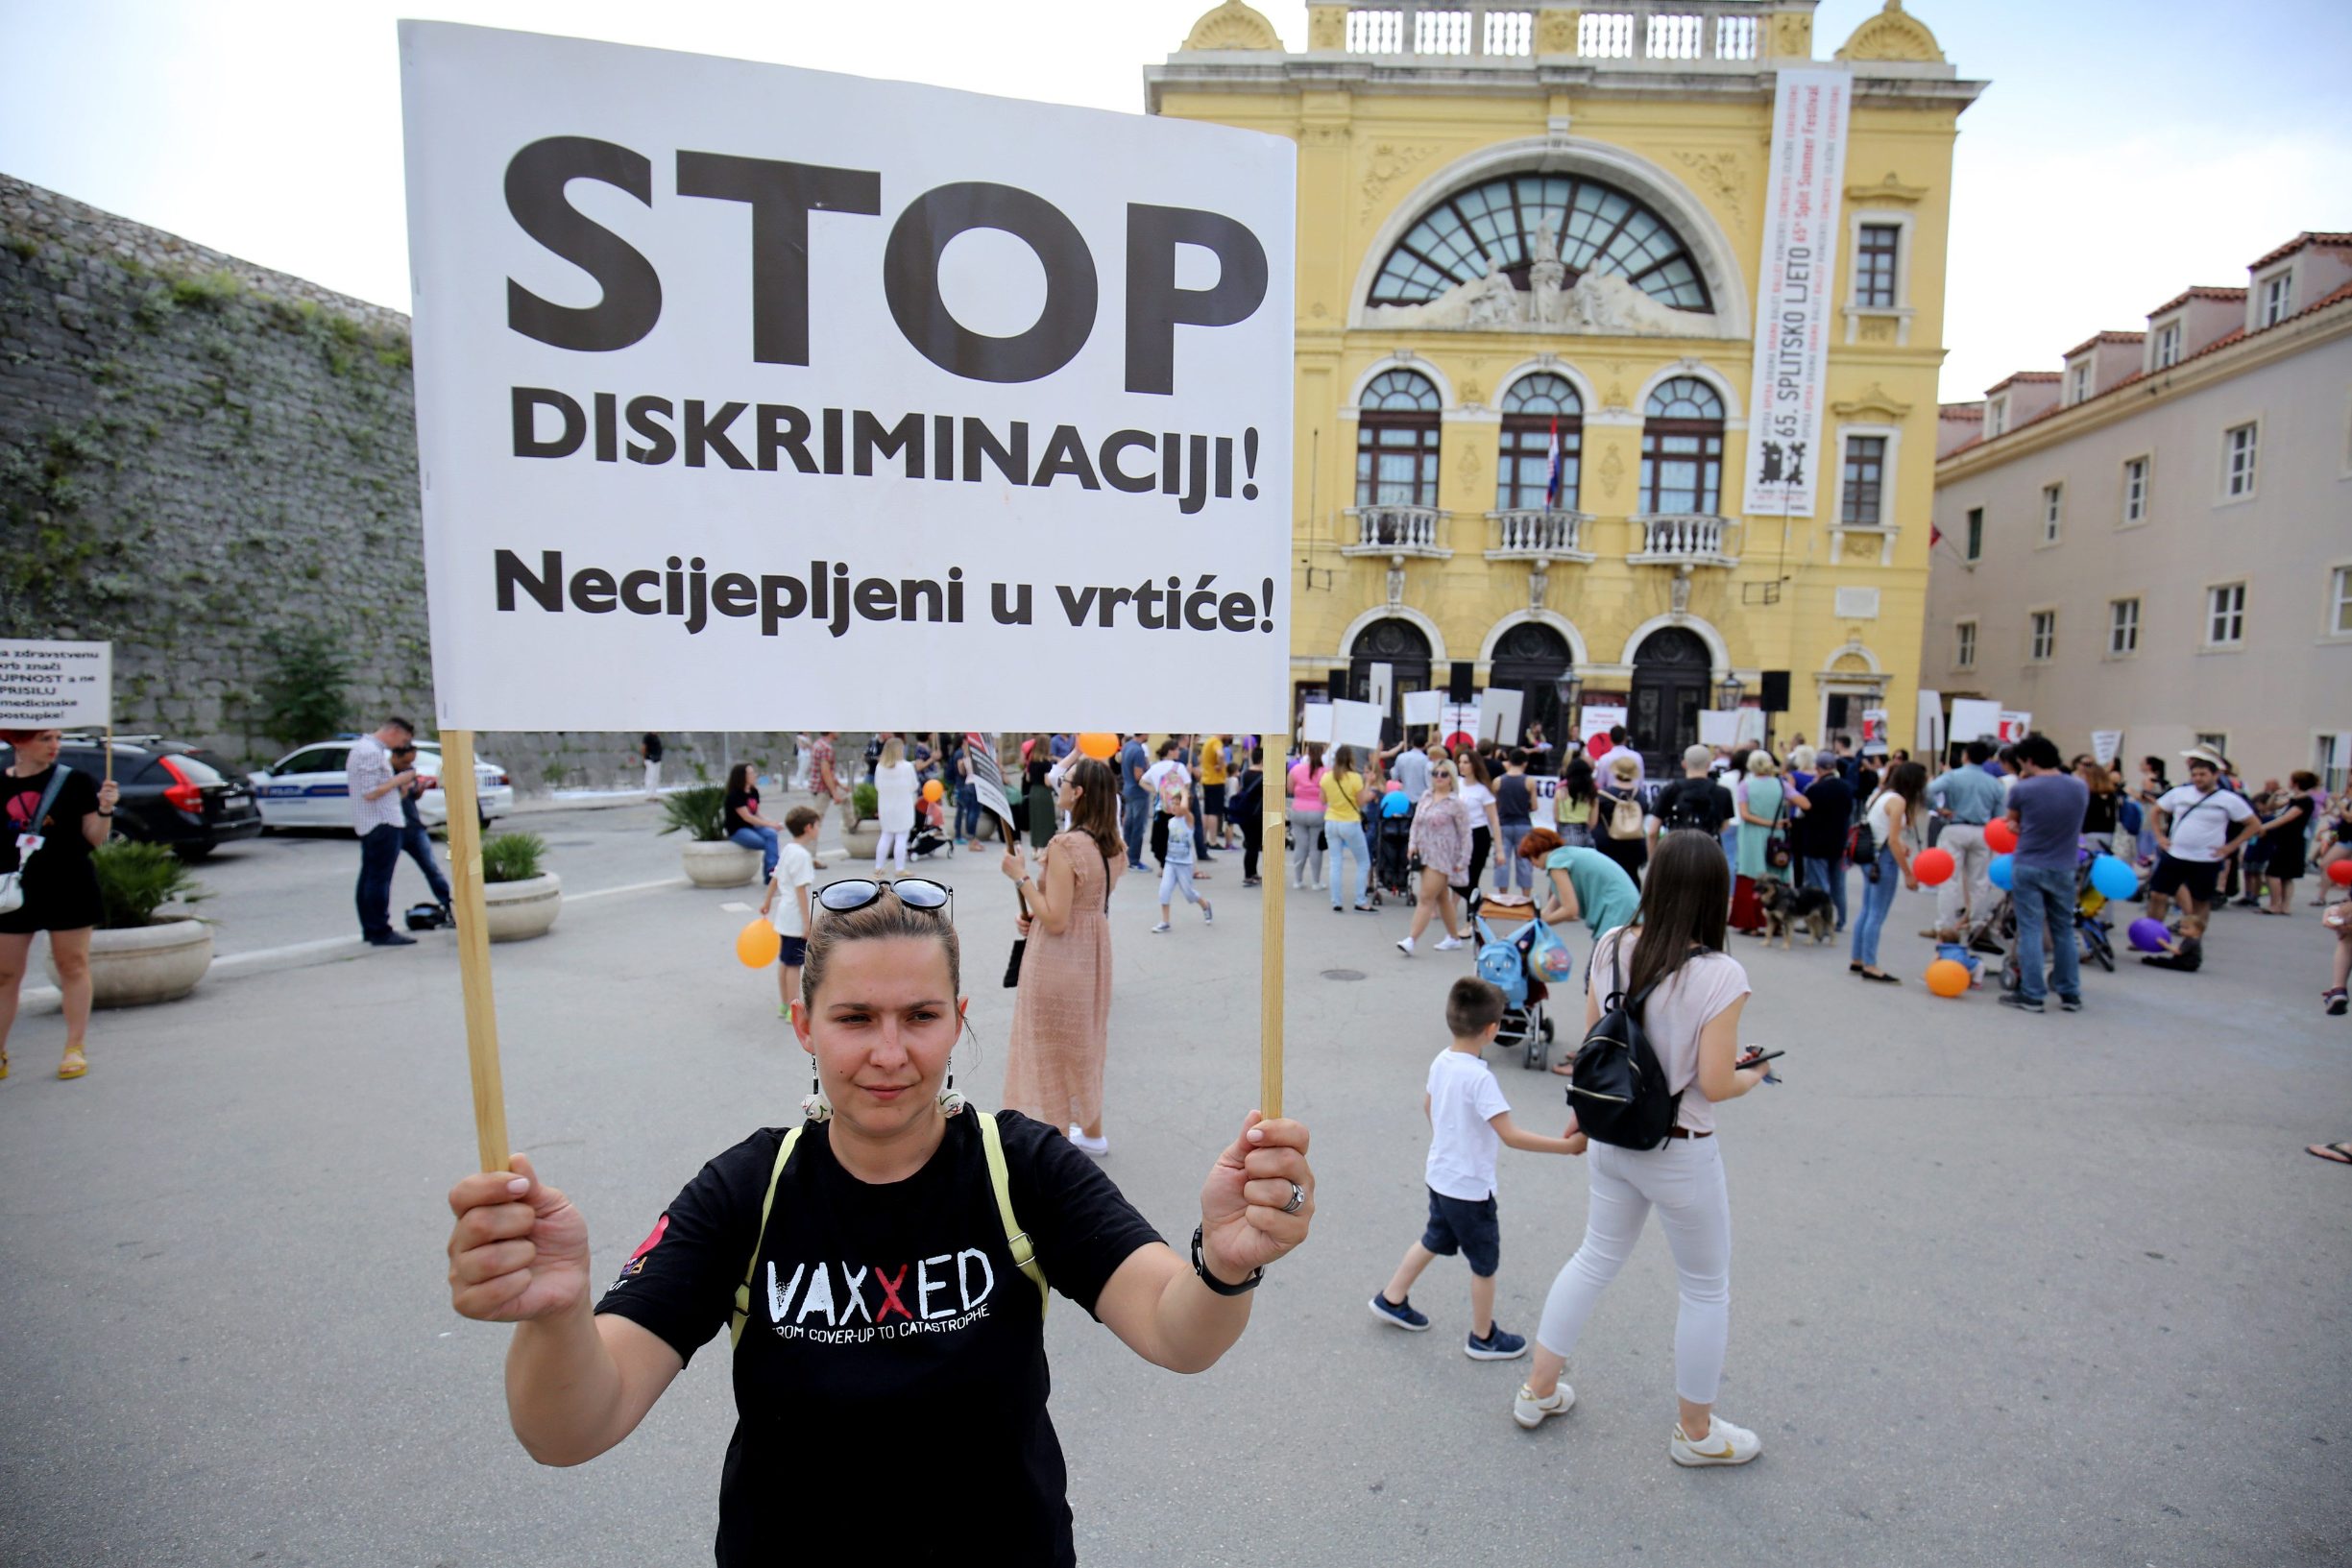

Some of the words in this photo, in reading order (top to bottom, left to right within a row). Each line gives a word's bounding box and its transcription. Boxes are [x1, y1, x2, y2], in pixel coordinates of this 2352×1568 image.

[1802, 84, 1819, 134] Festival
[1797, 138, 1814, 186] Summer
[1794, 191, 1811, 218] Split
[504, 135, 1269, 395] STOP
[1784, 248, 1810, 302] LJETO
[1778, 312, 1805, 400] SPLITSKO
[1775, 410, 1797, 438] 65.
[511, 386, 1260, 514] DISKRIMINACIJI!
[495, 549, 963, 637] Necijepljeni
[990, 583, 1031, 625] u
[1055, 574, 1274, 634] vrtiće!
[14, 649, 99, 659] zdravstvenu
[26, 663, 61, 671] znači
[0, 686, 56, 695] PRISILU
[1, 699, 78, 708] medicinske
[767, 1247, 994, 1327] VAXXED
[772, 1324, 805, 1339] ROM
[809, 1327, 875, 1344] COVER-UP
[880, 1326, 895, 1339] TO
[900, 1303, 990, 1338] CATASTROPHE
